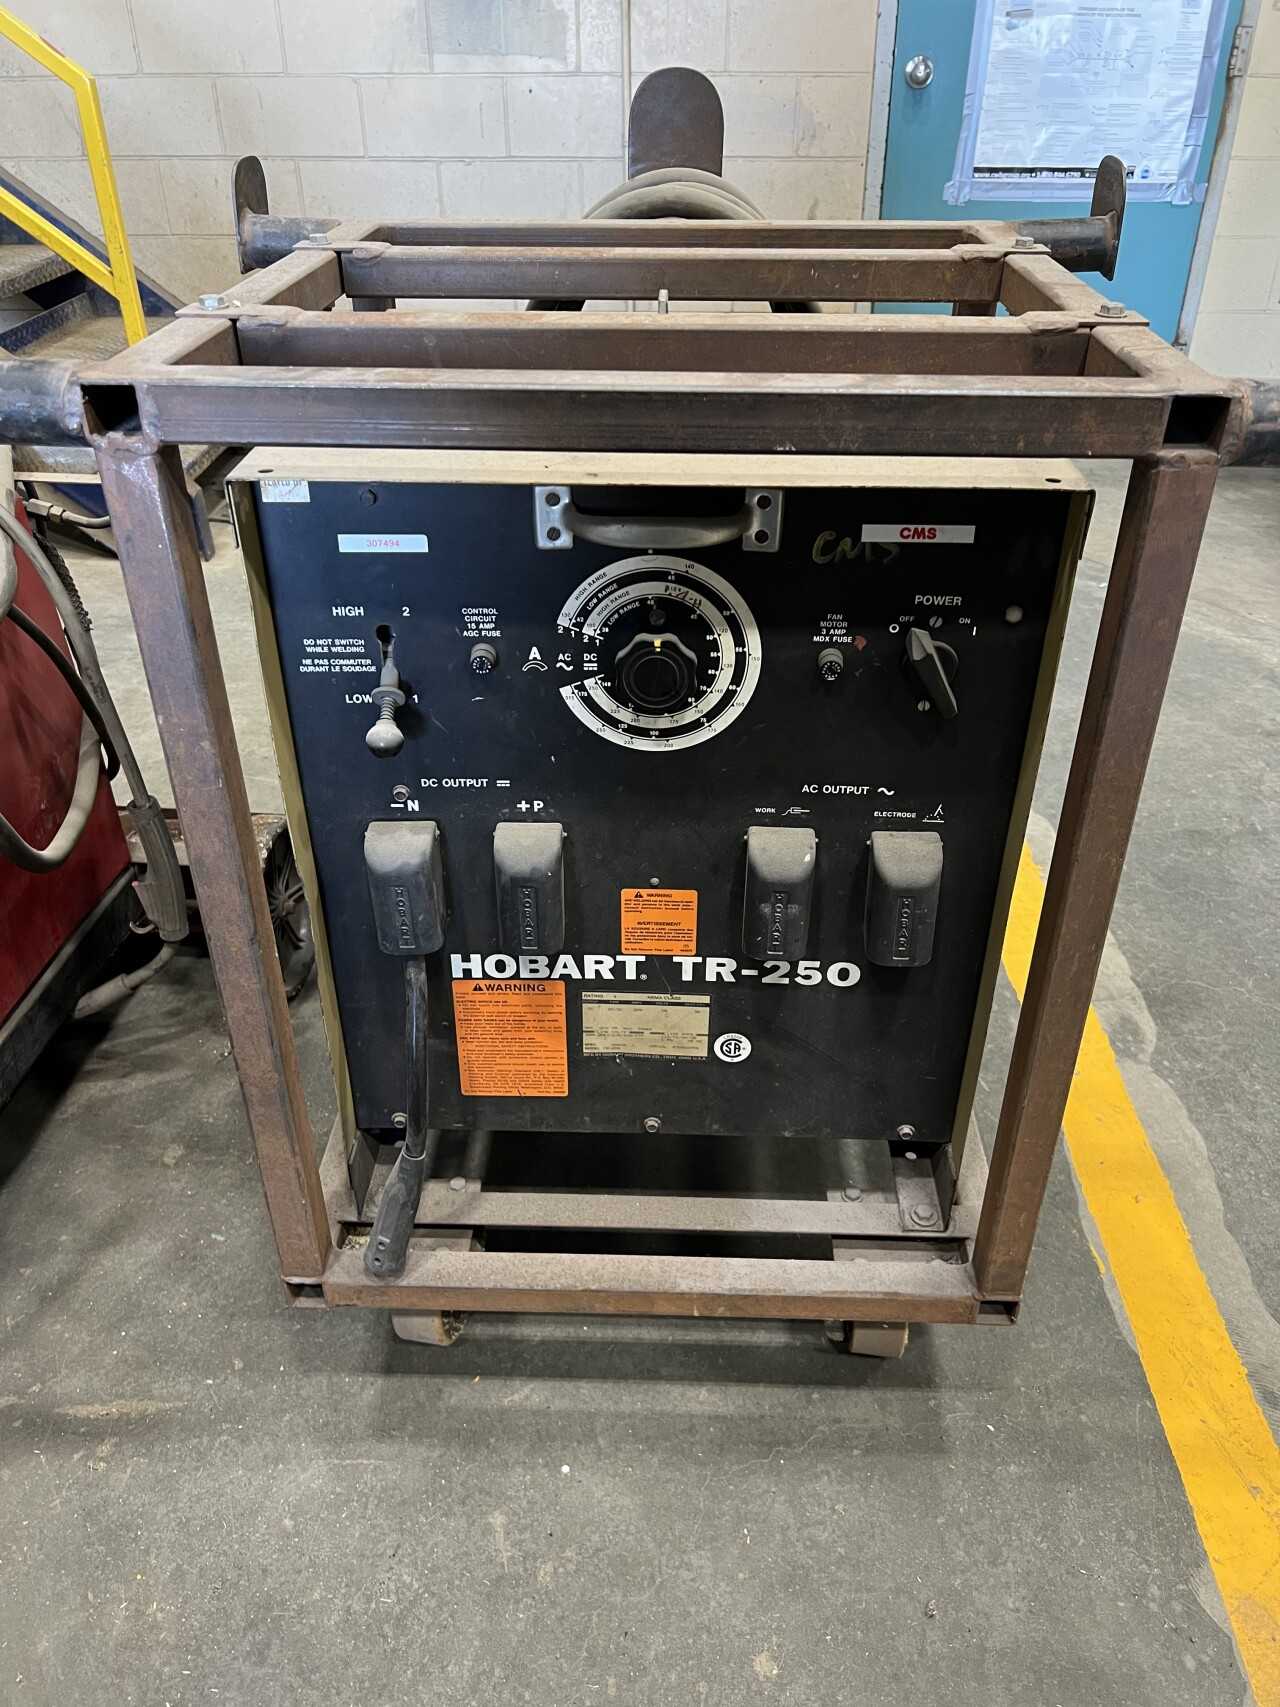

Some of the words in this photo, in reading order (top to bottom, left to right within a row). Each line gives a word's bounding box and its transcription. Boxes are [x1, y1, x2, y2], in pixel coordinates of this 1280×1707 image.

[899, 527, 937, 540] CMS
[587, 571, 608, 588] RANGE
[597, 582, 619, 599] RANGE
[610, 590, 630, 605] RANGE
[914, 594, 963, 607] POWER
[332, 606, 365, 617] HIGH
[402, 606, 411, 617] 2
[461, 607, 499, 615] CONTROL
[618, 600, 641, 615] RANGE
[827, 613, 843, 621] FAN
[899, 615, 915, 623] OFF
[466, 622, 477, 630] 15
[479, 622, 496, 630] AMP
[557, 625, 564, 634] 2
[819, 621, 848, 629] MOTOR
[481, 630, 502, 638] FUSE
[570, 630, 576, 638] 1
[583, 634, 589, 643] 2
[303, 638, 315, 646] DO
[316, 638, 332, 646] NOT
[334, 638, 365, 646] SWITCH
[594, 639, 600, 647] 1
[528, 646, 542, 660] A
[557, 653, 572, 661] AC
[583, 653, 598, 661] DC
[302, 658, 313, 666] NE
[314, 658, 329, 666] PAS
[330, 658, 372, 666] COMMUTER
[300, 665, 329, 673] DURANT
[330, 665, 341, 673] LE
[342, 665, 377, 673] SOUDAGE
[345, 693, 374, 704] LOW
[412, 694, 419, 704] 1
[420, 778, 438, 788] DC
[442, 778, 489, 788] OUTPUT
[801, 784, 819, 794] AC
[822, 784, 870, 795] OUTPUT
[873, 810, 917, 819] ELECTRODE
[672, 956, 861, 987] TR-250
[484, 983, 546, 992] WARNING
